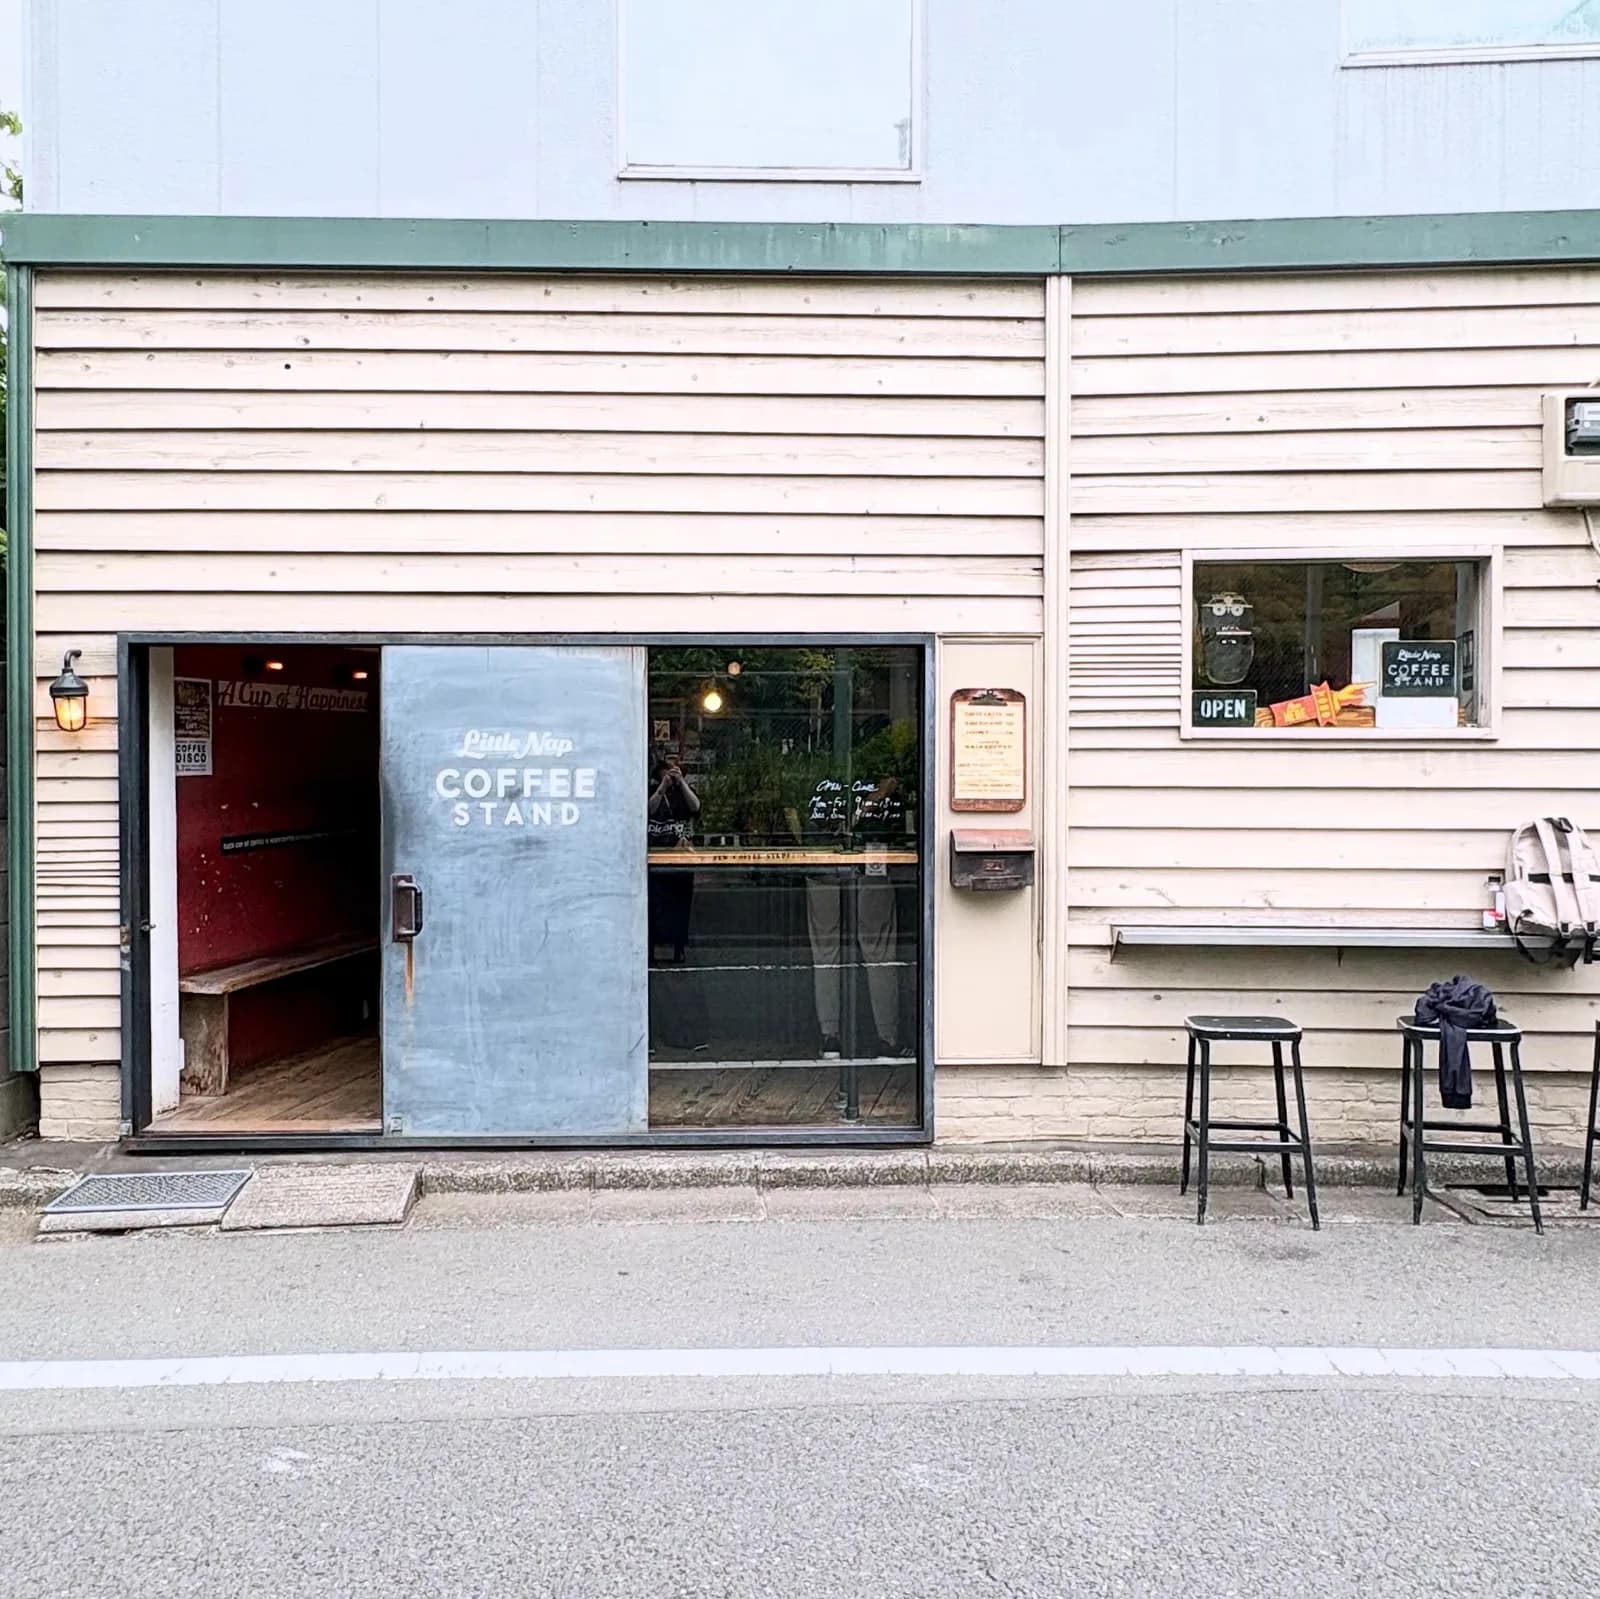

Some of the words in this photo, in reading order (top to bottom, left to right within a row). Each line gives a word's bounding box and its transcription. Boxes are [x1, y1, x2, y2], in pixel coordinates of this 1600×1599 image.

[1387, 664, 1450, 676] COFFEE
[1394, 676, 1444, 687] STAND
[1200, 699, 1246, 718] OPEN
[175, 744, 207, 753] COFFEE
[512, 730, 574, 760] Nap
[175, 753, 207, 763] DISCO
[435, 768, 596, 798] COFFEE
[454, 801, 580, 826] STAND
